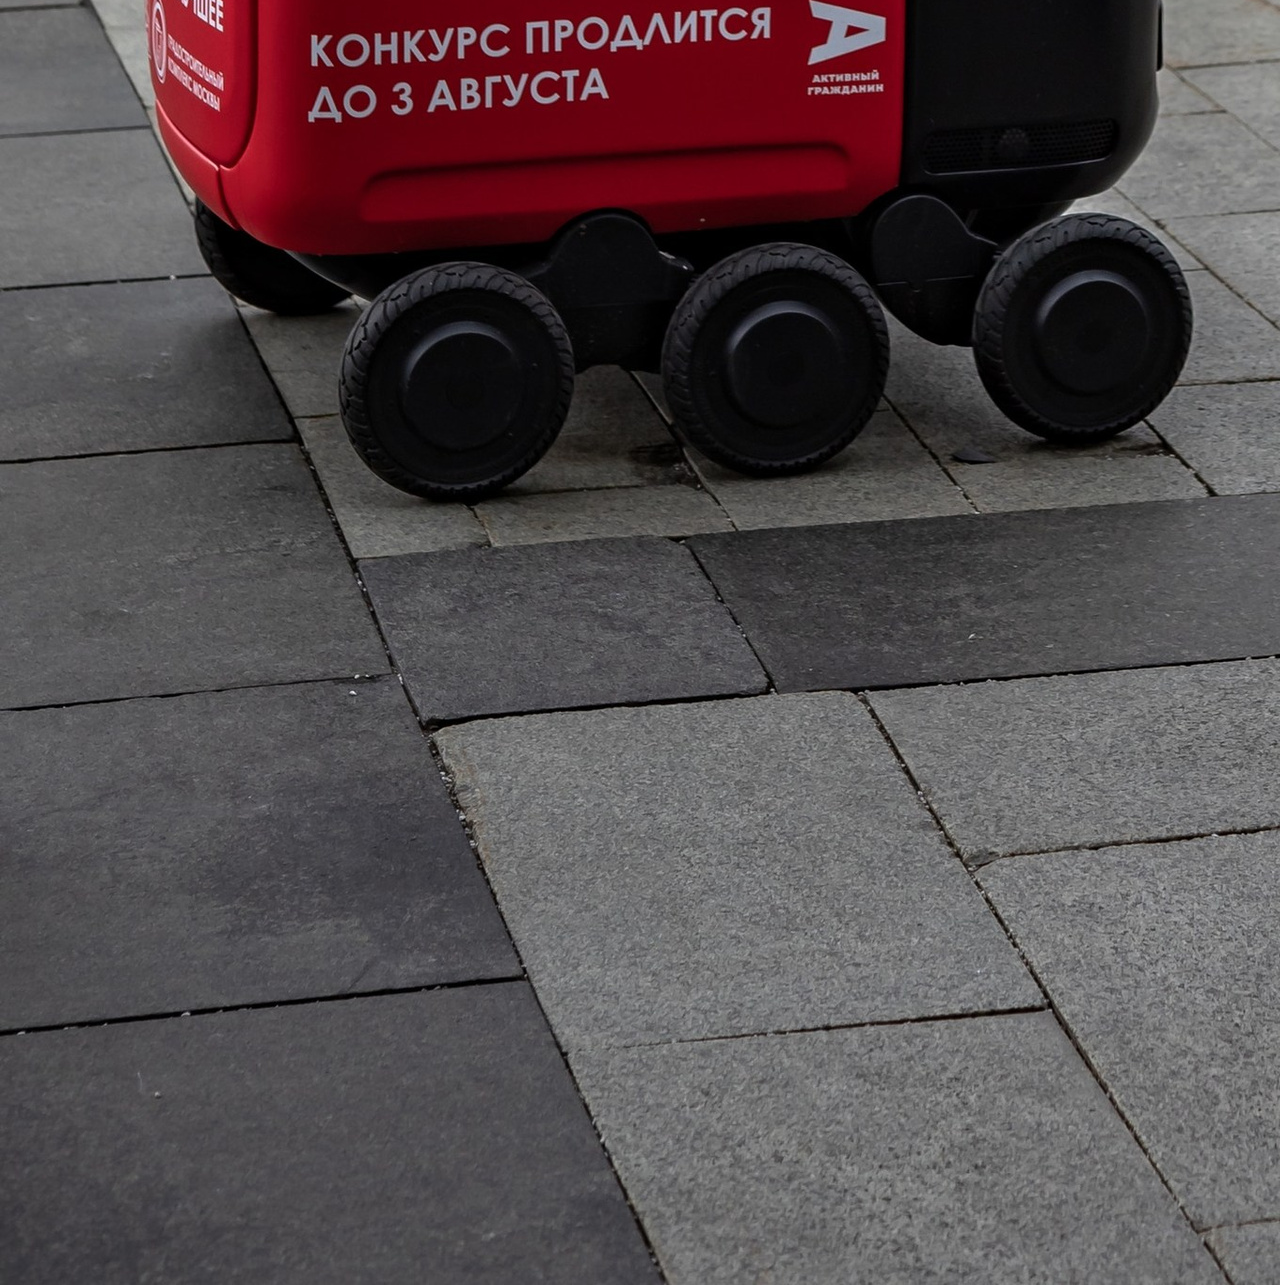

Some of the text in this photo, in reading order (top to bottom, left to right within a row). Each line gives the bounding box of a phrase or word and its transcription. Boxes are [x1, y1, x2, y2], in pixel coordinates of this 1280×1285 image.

[309, 6, 772, 69] КОНКУРС ПРОДЛИТСЯ
[806, 83, 885, 97] ГРАЖДАНИН
[811, 69, 880, 84] АКТИВНЫЙ
[307, 67, 610, 124] ДО 3 АВГУСТА
